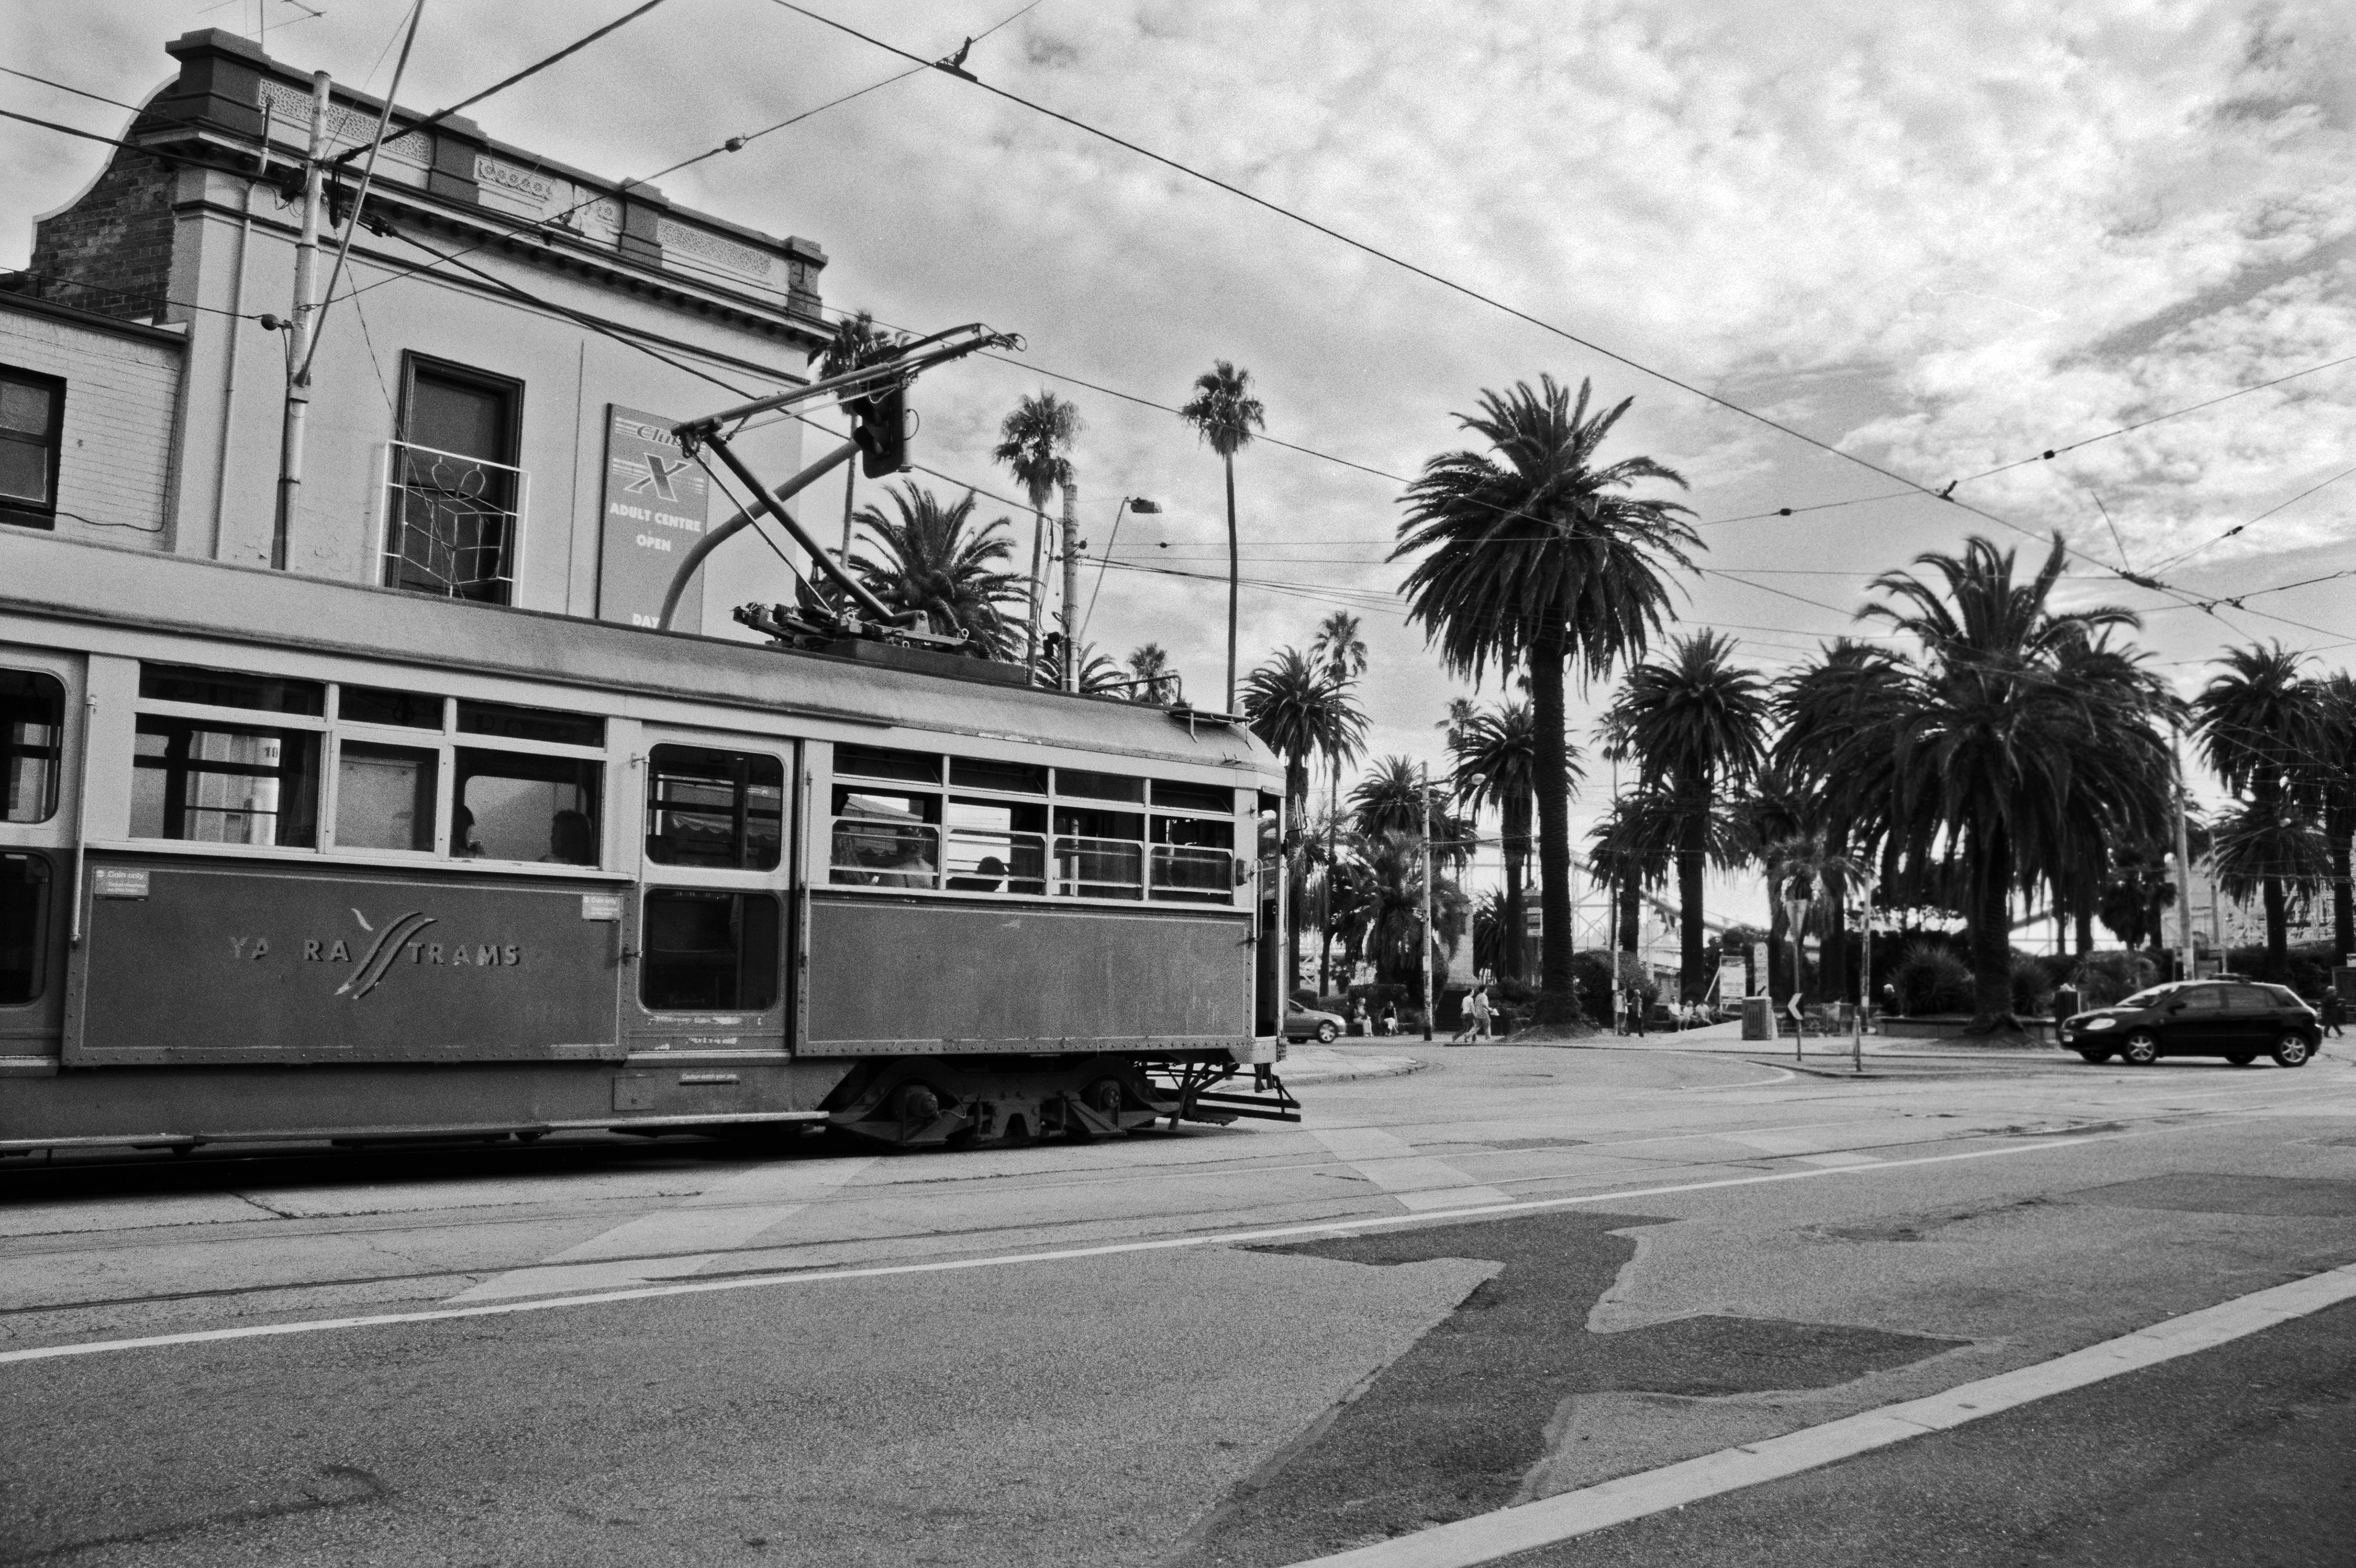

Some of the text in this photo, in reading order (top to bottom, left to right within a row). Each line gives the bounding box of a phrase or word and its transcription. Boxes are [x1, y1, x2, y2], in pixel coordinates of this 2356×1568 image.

[624, 453, 692, 502] X
[610, 502, 701, 532] ADULT CENTRE
[636, 534, 671, 551] OPEN
[408, 941, 520, 966] TRAMS
